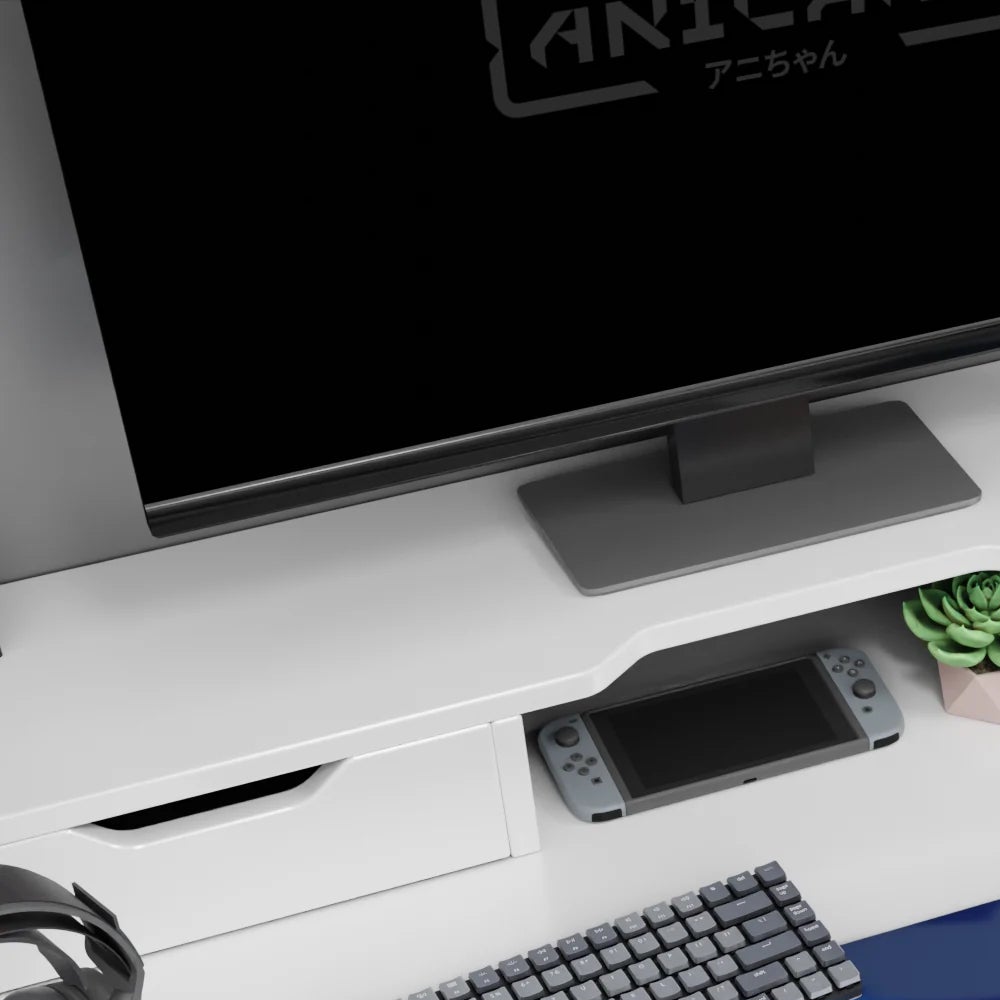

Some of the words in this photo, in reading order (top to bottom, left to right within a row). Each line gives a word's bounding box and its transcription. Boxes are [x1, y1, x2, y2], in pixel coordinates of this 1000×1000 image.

[705, 39, 847, 89] アニちゃん
